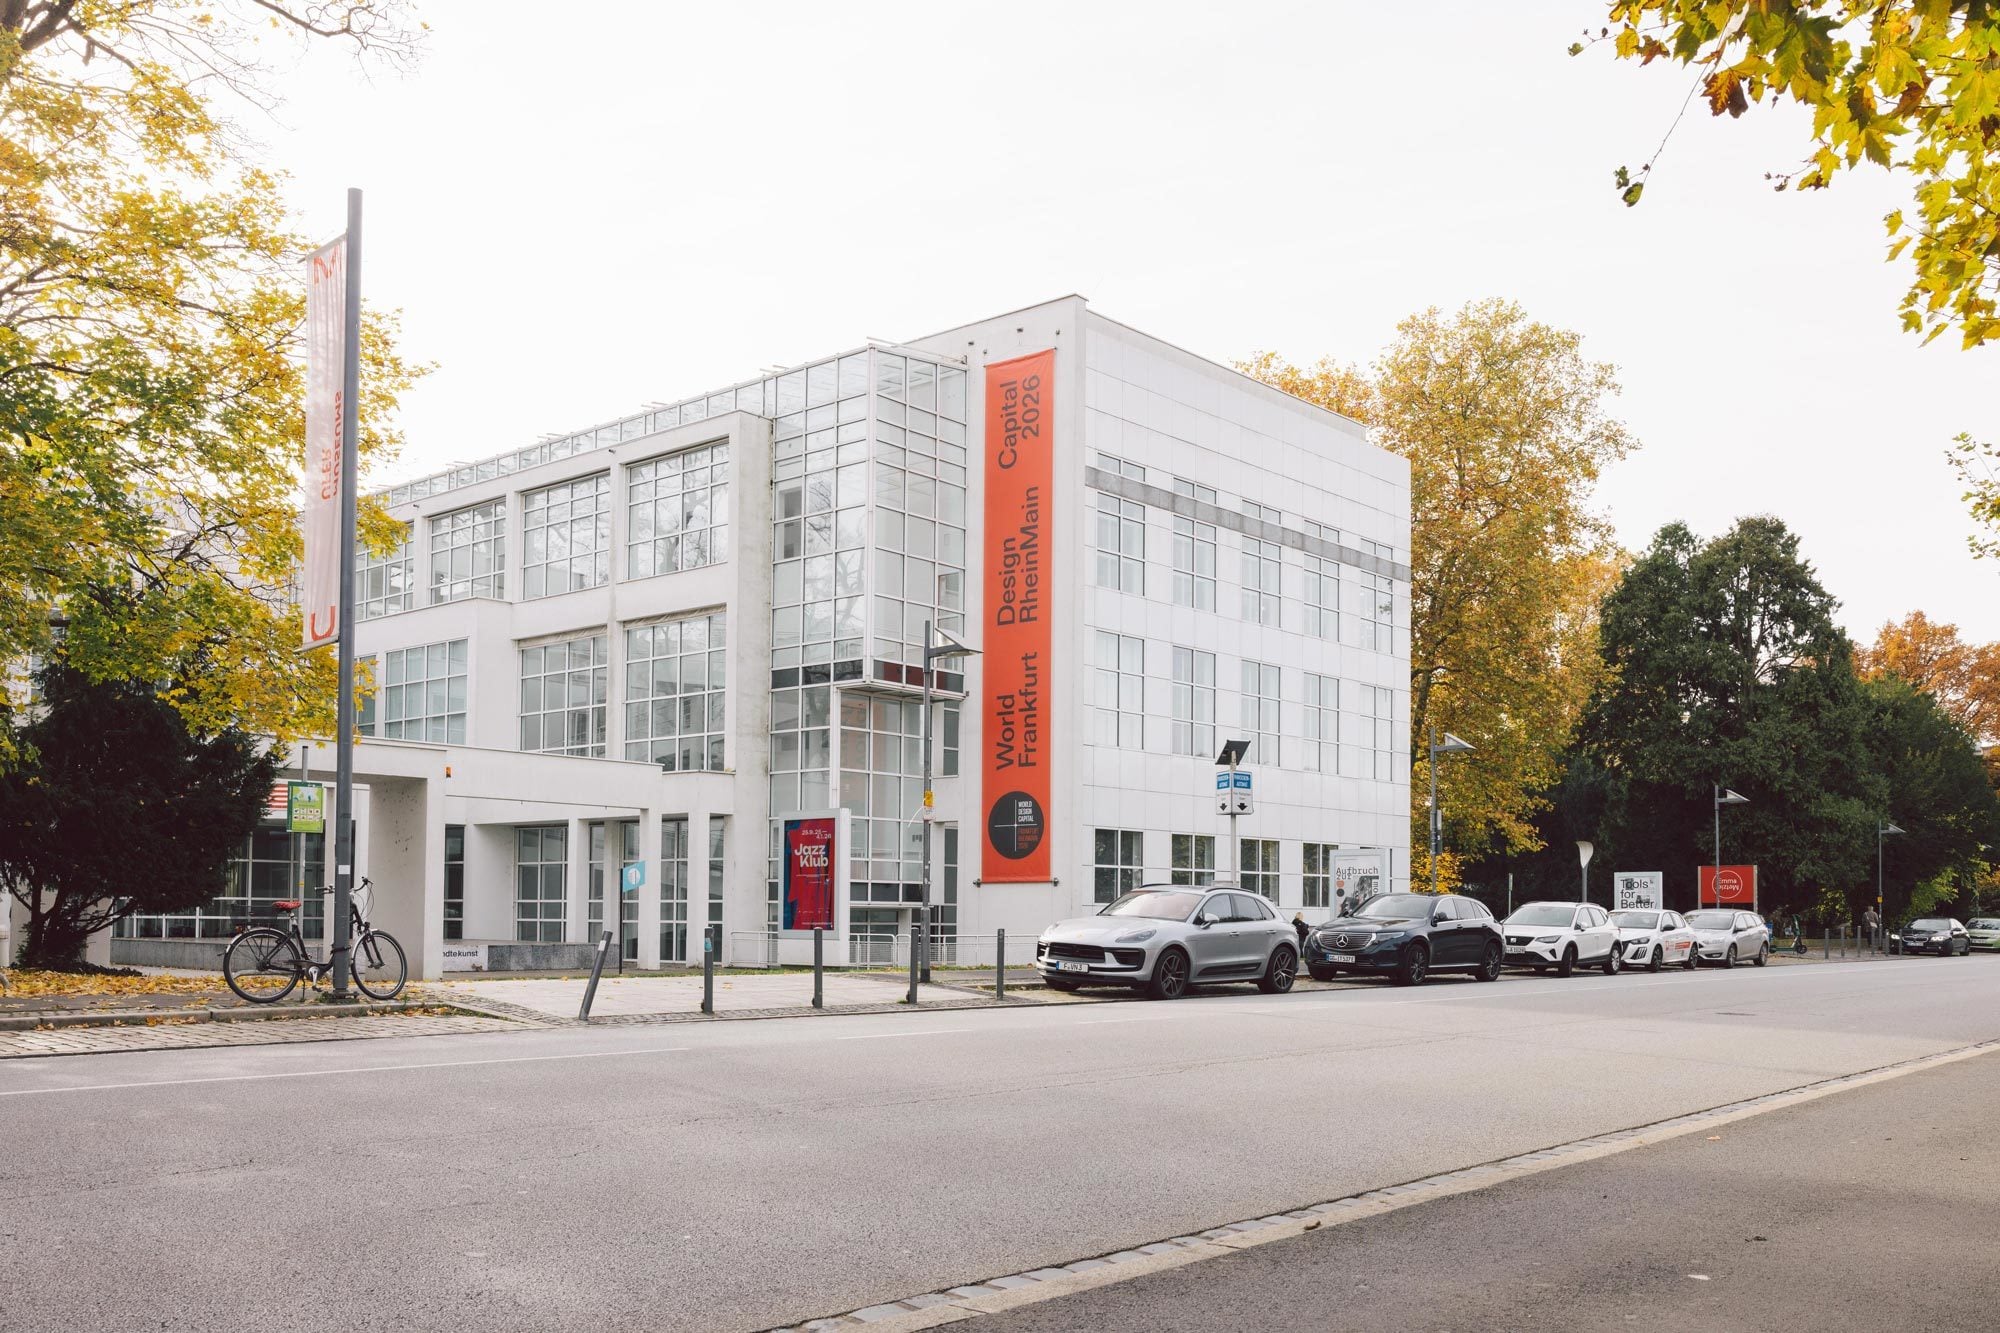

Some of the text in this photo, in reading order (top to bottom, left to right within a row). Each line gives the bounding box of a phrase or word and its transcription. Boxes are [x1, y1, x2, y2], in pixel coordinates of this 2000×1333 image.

[996, 380, 1022, 771] World Design Capital
[1018, 374, 1041, 768] Frankfurt RheinMain 2026
[795, 844, 826, 856] Jazz
[800, 855, 829, 868] Klub
[1336, 866, 1379, 875] Aufbruch
[1620, 879, 1649, 889] Tools
[1620, 890, 1636, 899] for
[1620, 899, 1655, 909] Better
